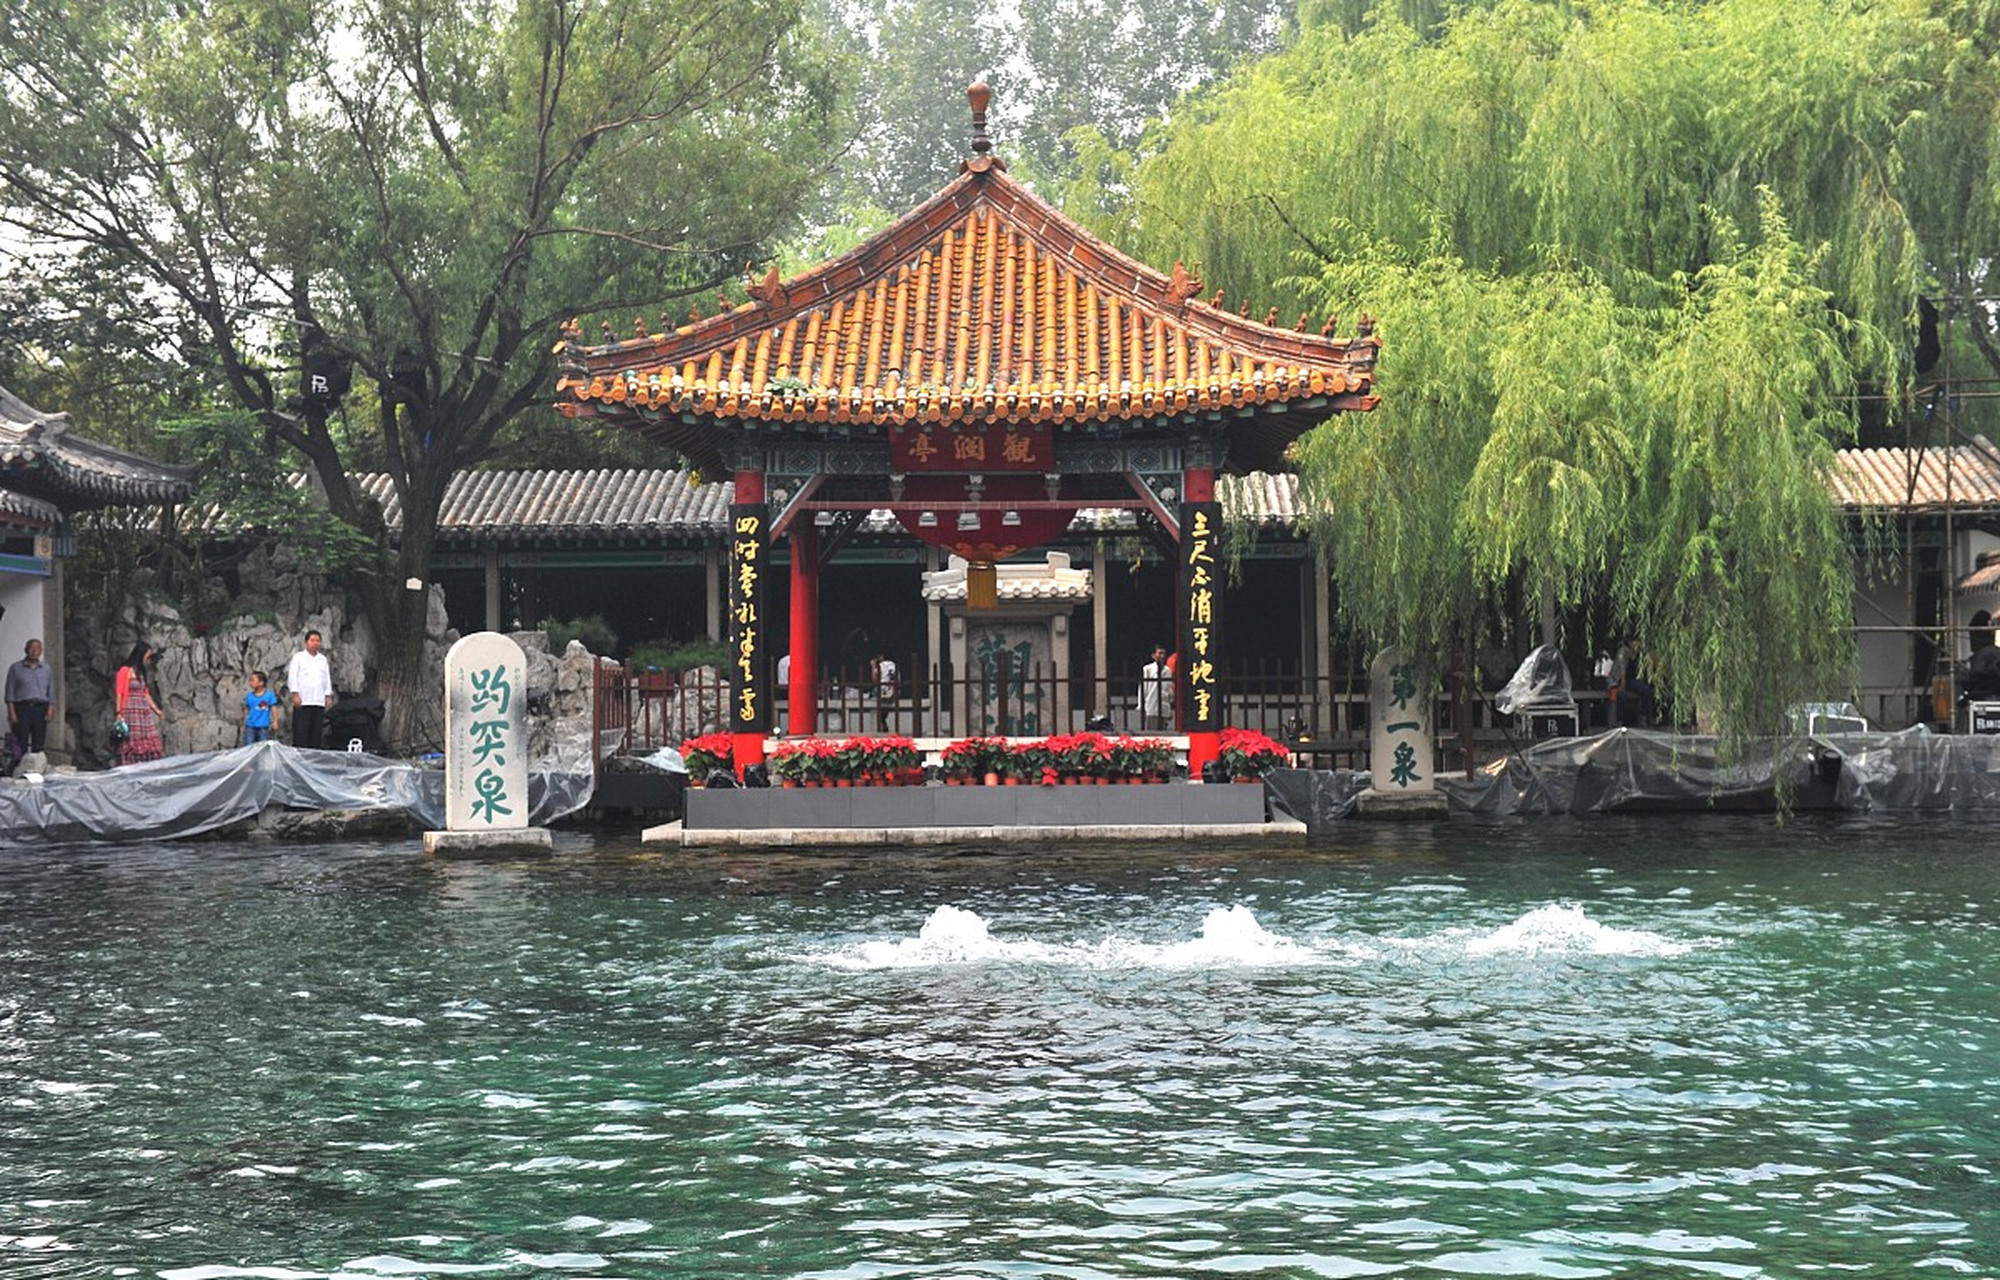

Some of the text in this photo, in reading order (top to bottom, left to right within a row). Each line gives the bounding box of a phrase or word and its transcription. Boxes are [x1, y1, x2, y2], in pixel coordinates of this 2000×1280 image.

[468, 664, 513, 824] 趵突泉
[1386, 664, 1422, 789] 第一泉
